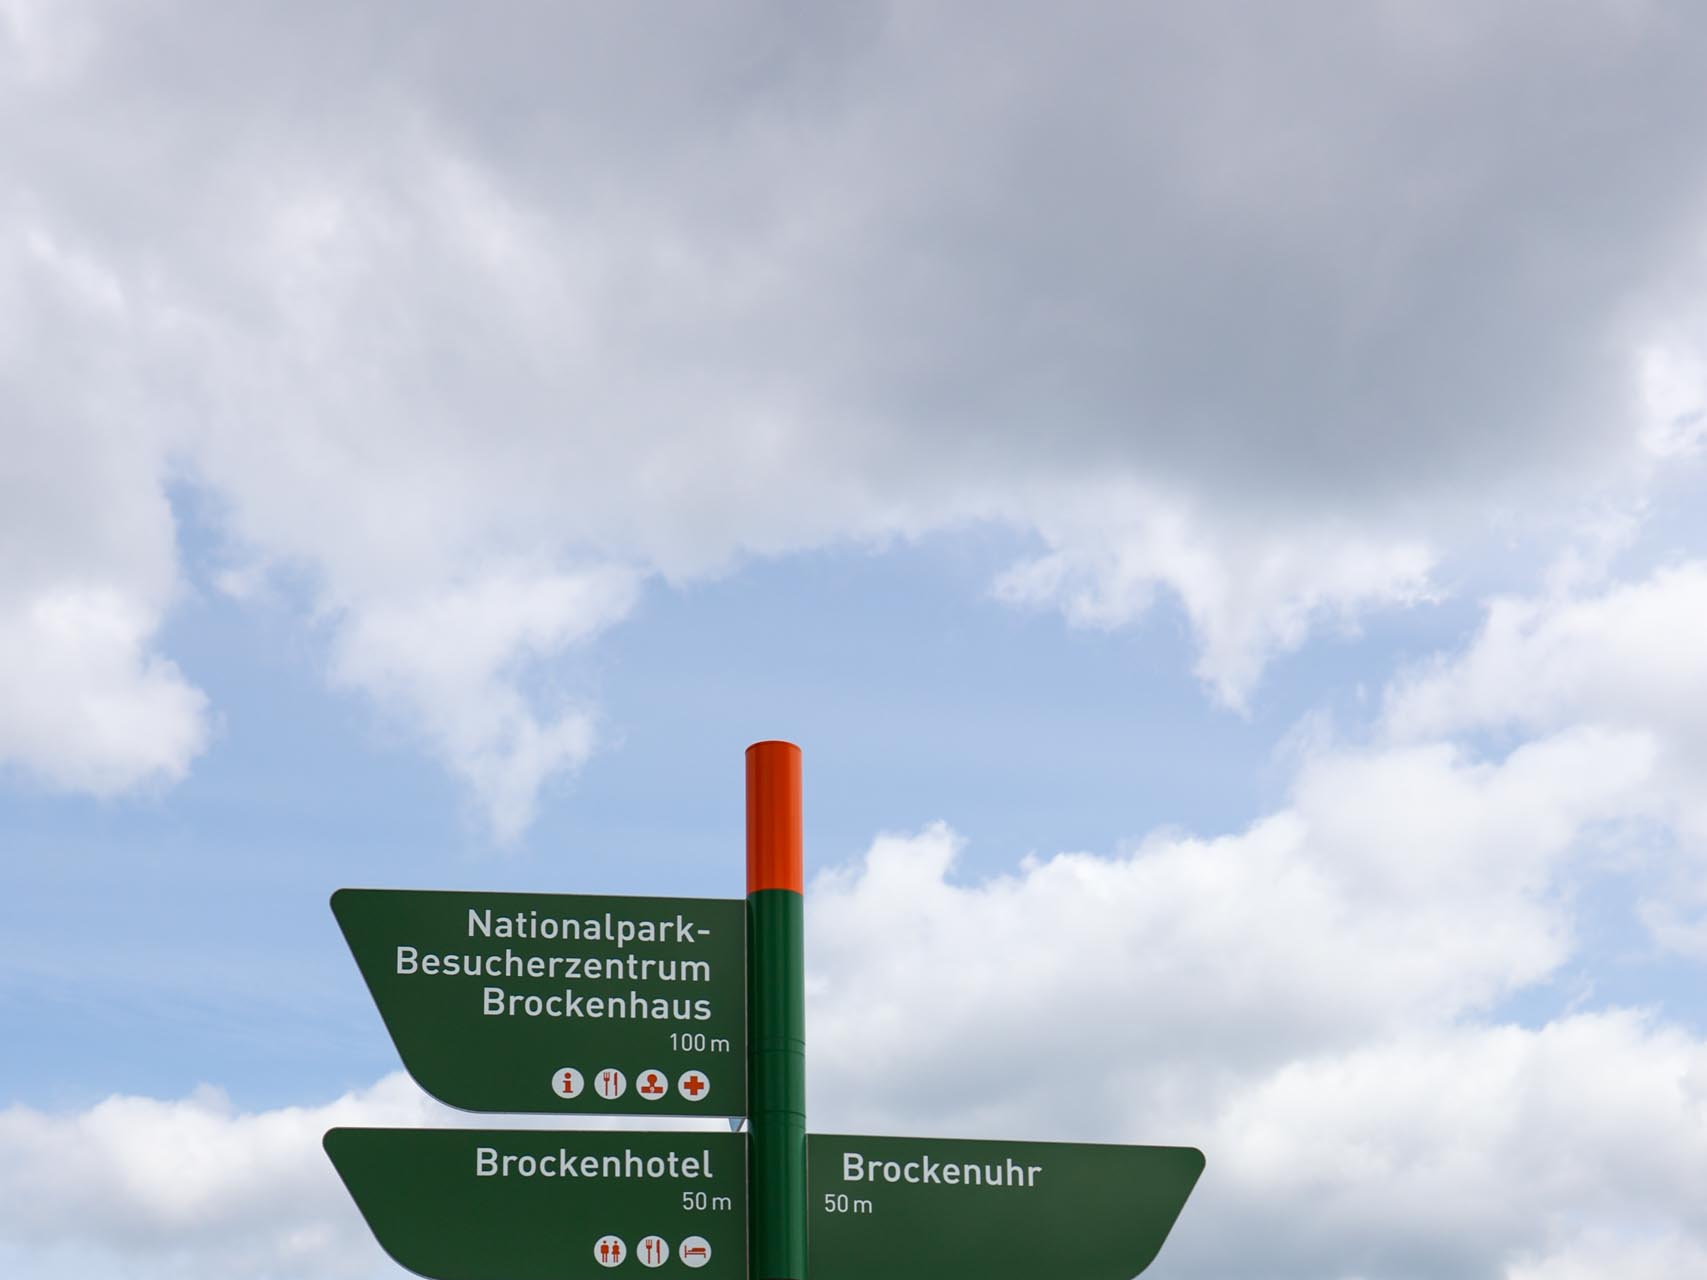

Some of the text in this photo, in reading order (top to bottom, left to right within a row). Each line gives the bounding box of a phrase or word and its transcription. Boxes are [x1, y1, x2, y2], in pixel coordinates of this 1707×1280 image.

[467, 909, 711, 948] Nationalpark-
[396, 946, 711, 982] Besucherzentrum
[483, 987, 712, 1021] Brockenhaus
[670, 1032, 730, 1052] 100 m
[476, 1147, 713, 1178] Brockenhotel
[842, 1152, 1043, 1187] Brockenuhr
[682, 1191, 732, 1211] 50 m
[824, 1193, 873, 1214] 50 m
